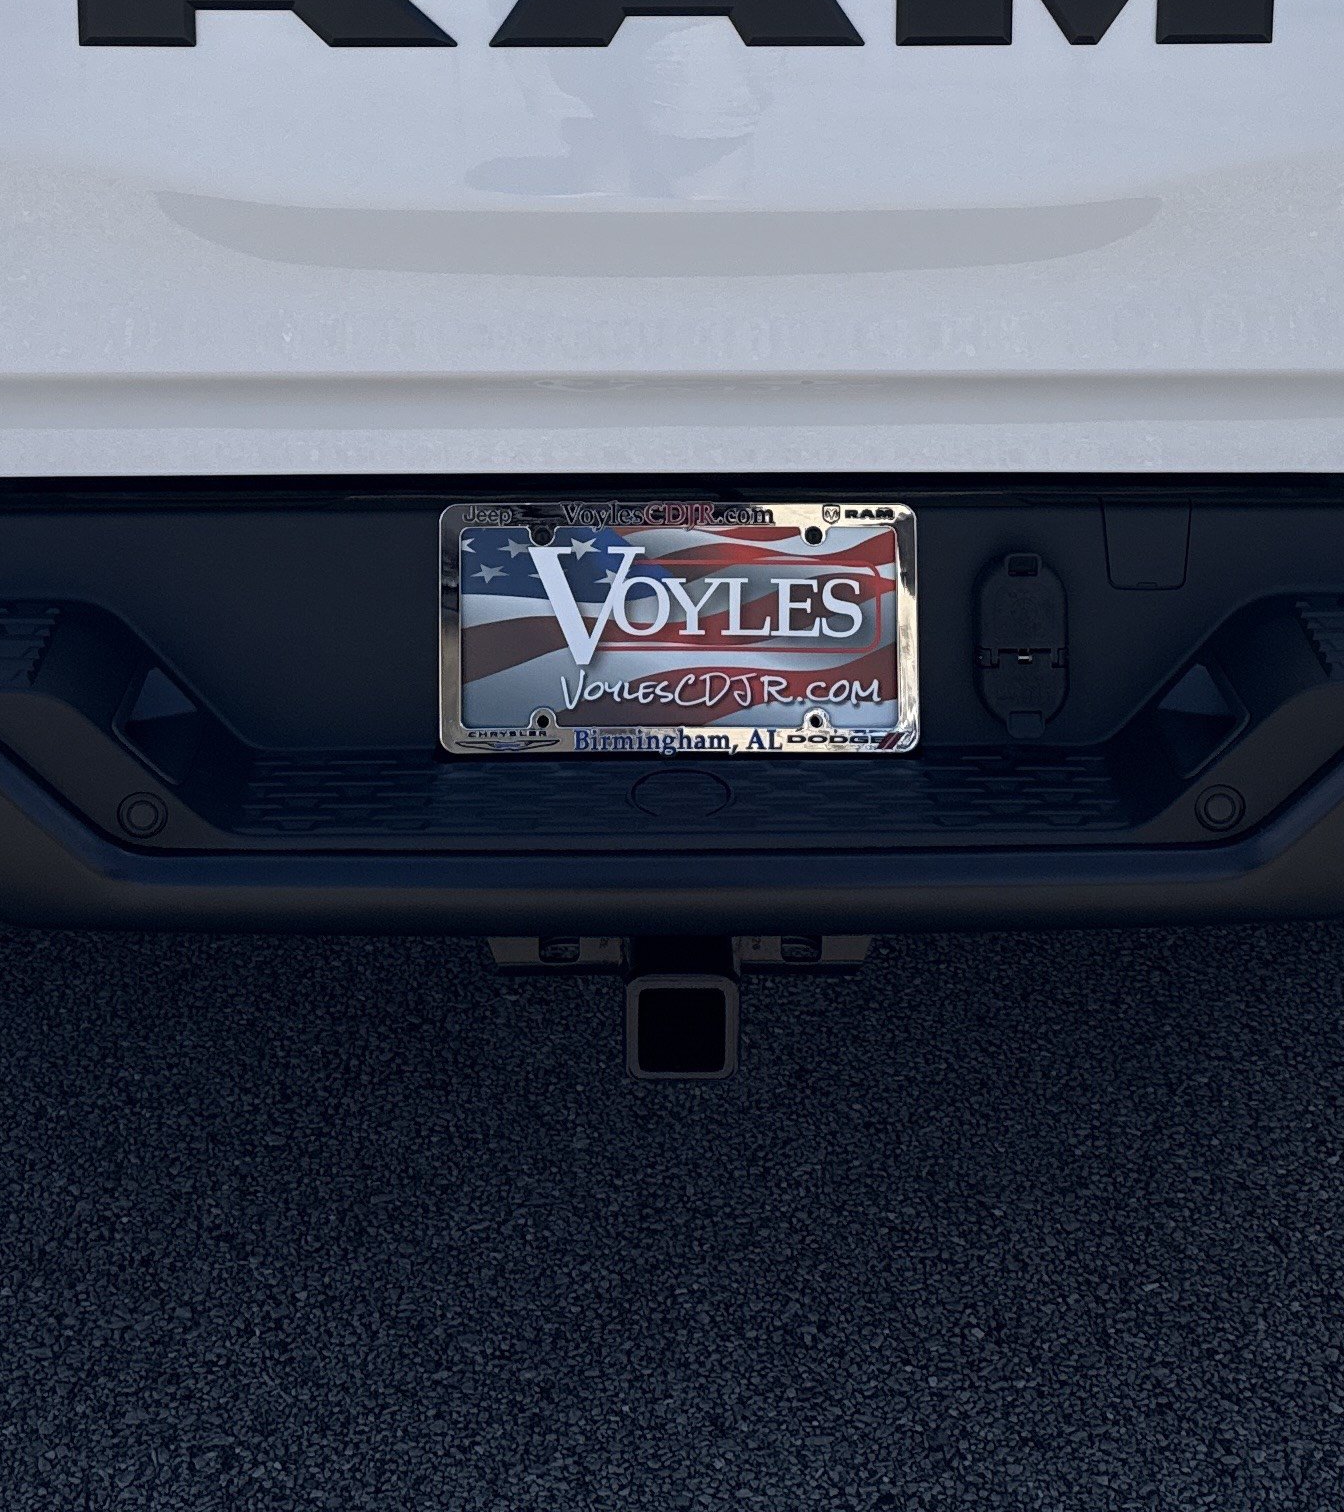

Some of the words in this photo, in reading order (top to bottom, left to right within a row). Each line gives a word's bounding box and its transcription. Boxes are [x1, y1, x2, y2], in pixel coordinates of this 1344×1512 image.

[462, 504, 514, 527] Jeep
[559, 500, 776, 532] VoylesCDJR.com
[844, 508, 896, 521] RAM
[528, 546, 864, 666] VOYLES
[573, 727, 739, 756] Birmingham,
[747, 728, 783, 751] AL
[786, 733, 887, 744] DODGE
